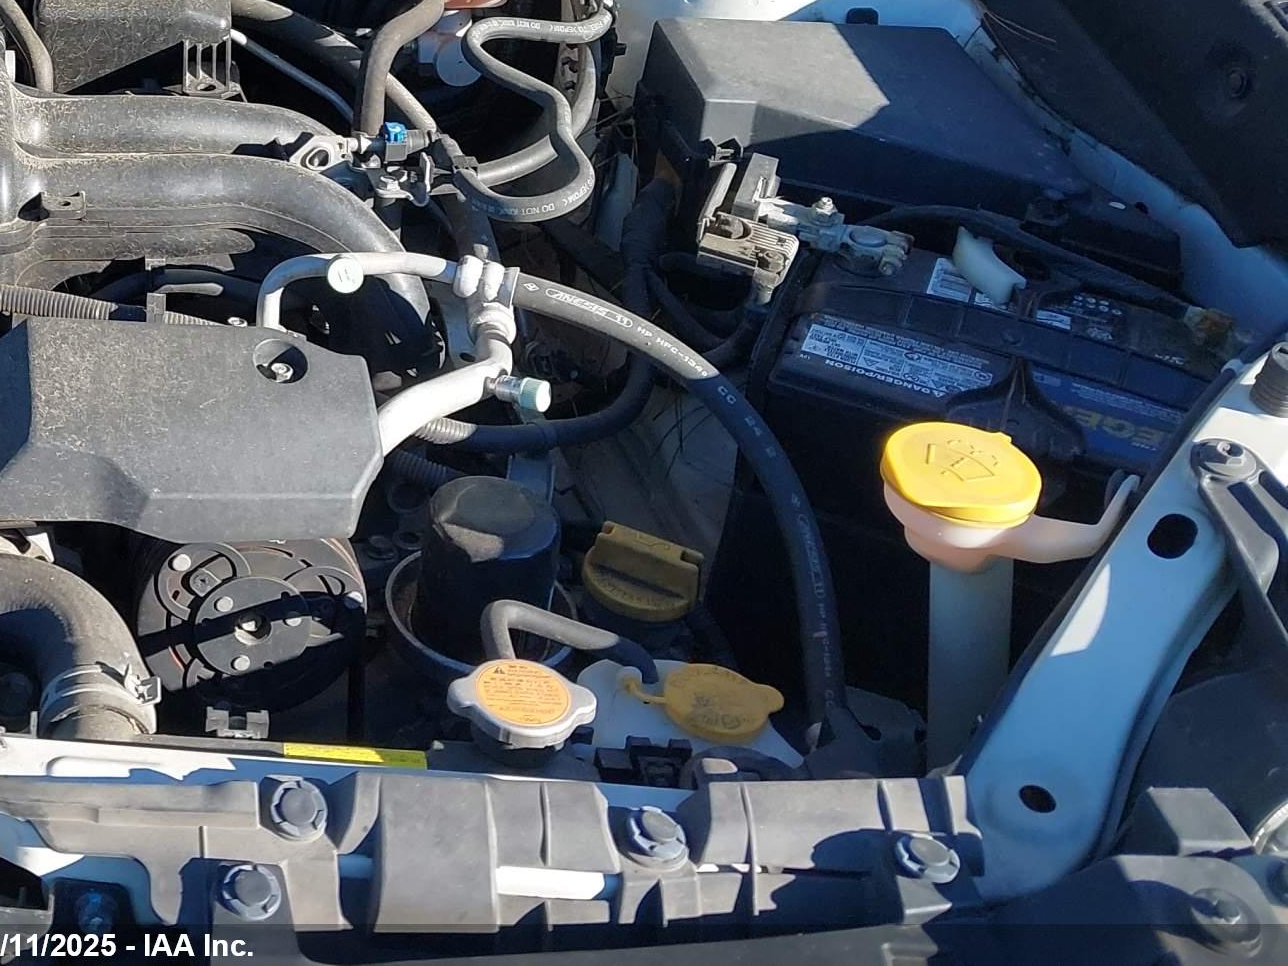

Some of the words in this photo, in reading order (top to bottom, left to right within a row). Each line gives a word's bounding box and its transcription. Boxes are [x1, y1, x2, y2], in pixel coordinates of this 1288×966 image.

[522, 206, 540, 215] NOT
[541, 203, 555, 212] DO
[824, 359, 932, 395] DANGER/POISON
